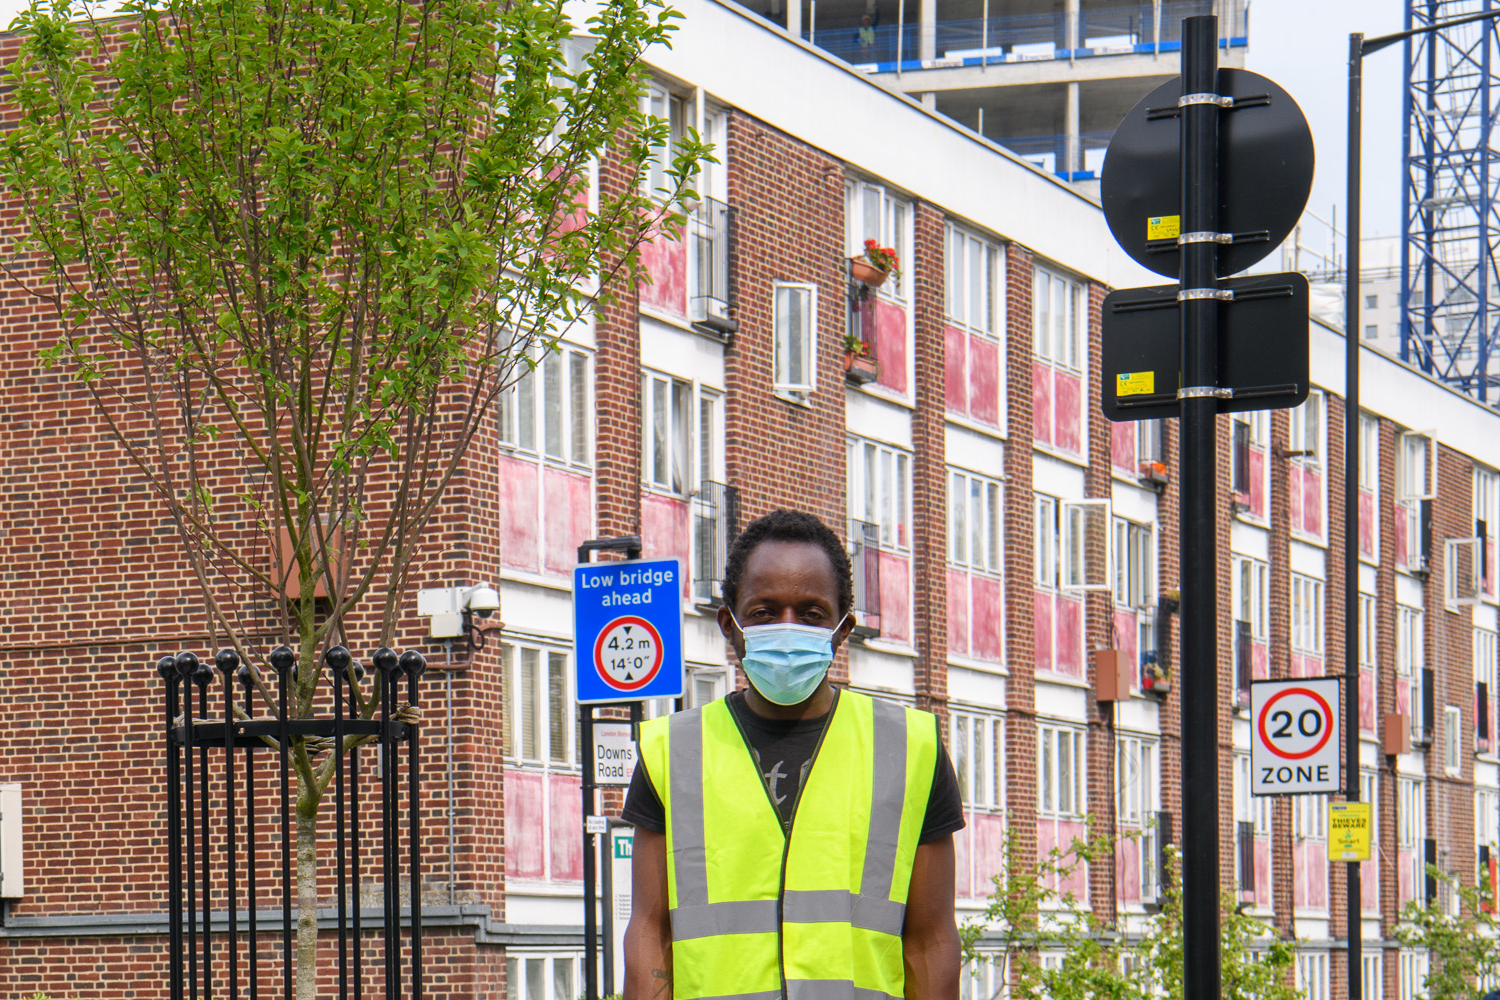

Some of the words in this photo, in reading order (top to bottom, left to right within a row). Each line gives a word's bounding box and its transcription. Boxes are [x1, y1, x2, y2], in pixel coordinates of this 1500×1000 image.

[582, 573, 614, 588] Low
[620, 568, 674, 587] bridge
[602, 589, 652, 607] ahead
[608, 636, 634, 651] 4.2
[638, 639, 650, 649] m
[1271, 709, 1322, 738] 20
[597, 744, 632, 760] Downs
[598, 762, 624, 777] Road
[1261, 765, 1330, 784] ZONE
